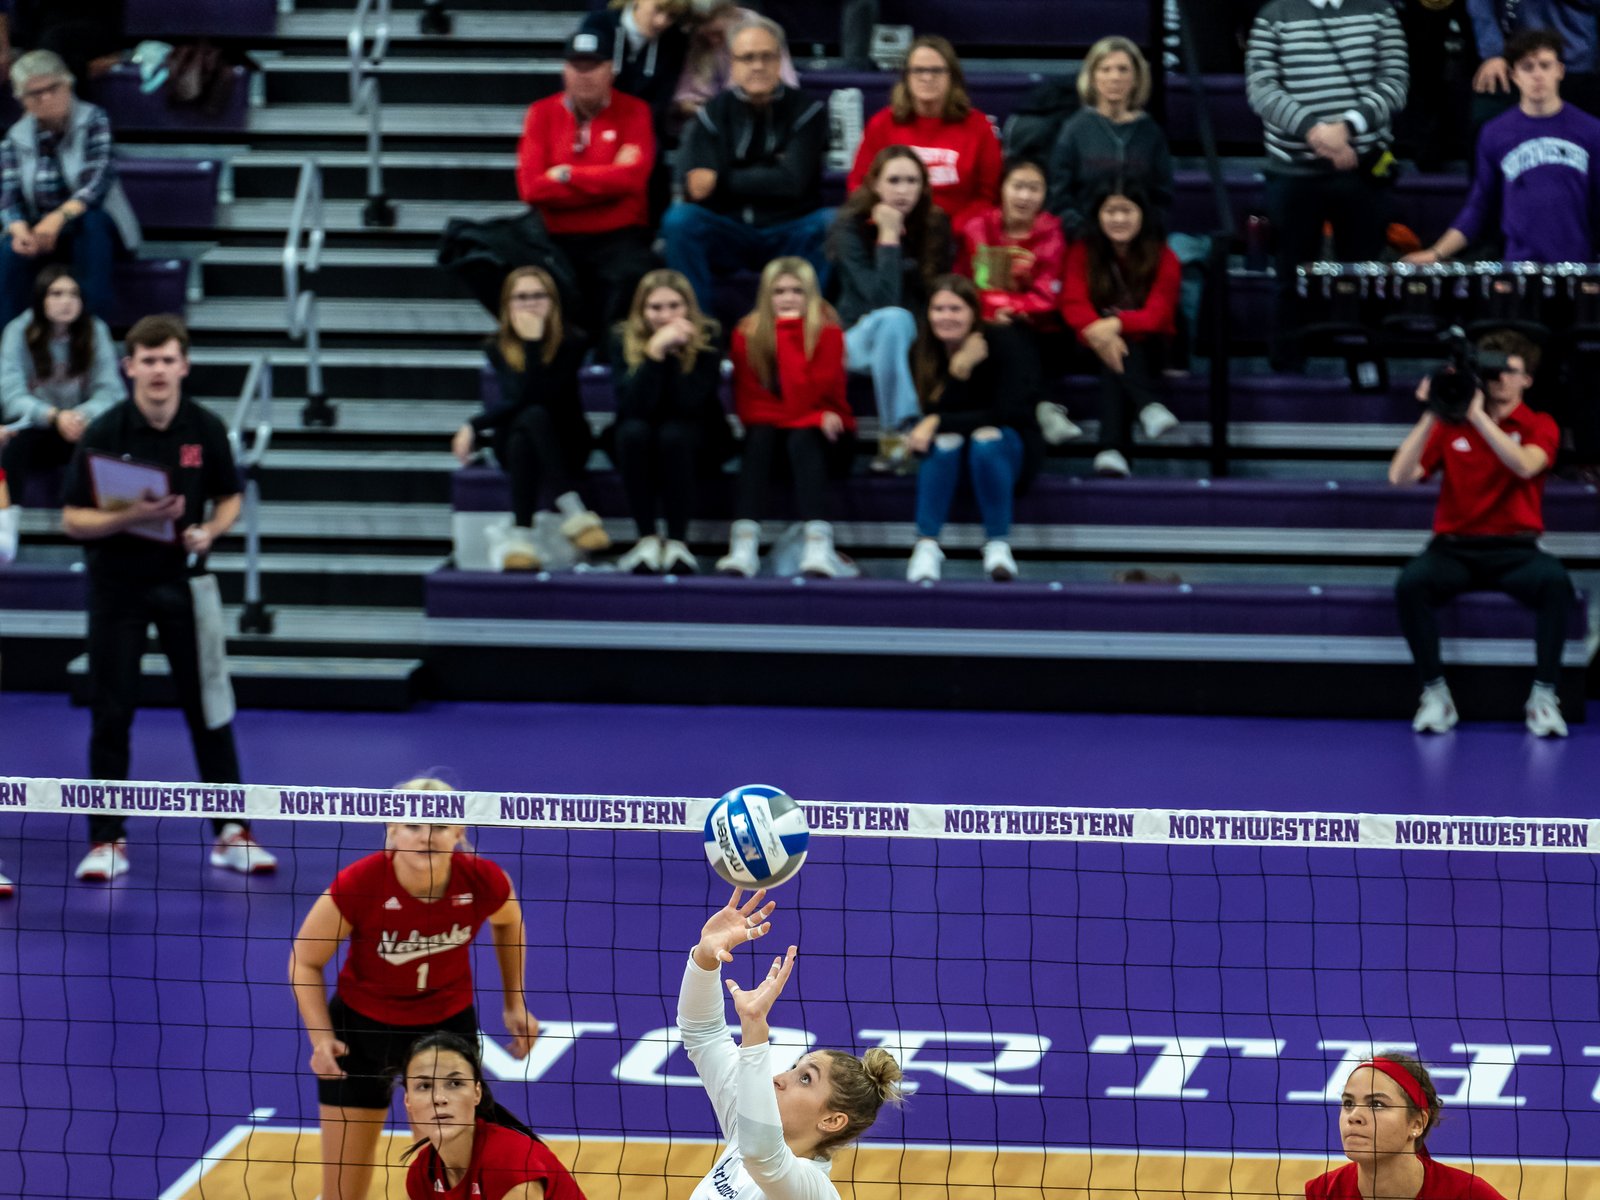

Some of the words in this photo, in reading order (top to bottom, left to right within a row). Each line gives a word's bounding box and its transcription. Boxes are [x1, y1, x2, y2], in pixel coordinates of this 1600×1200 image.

[61, 784, 246, 813] NORTHWESTERN
[279, 791, 466, 819] NORTHWESTERN
[500, 796, 687, 825] NORTHWESTERN
[944, 809, 1135, 837] NORTHWESTERN
[1168, 815, 1360, 842] NORTHWESTERN
[1395, 820, 1589, 847] NORTHWESTERN
[716, 816, 745, 873] molten
[416, 962, 430, 991] 1
